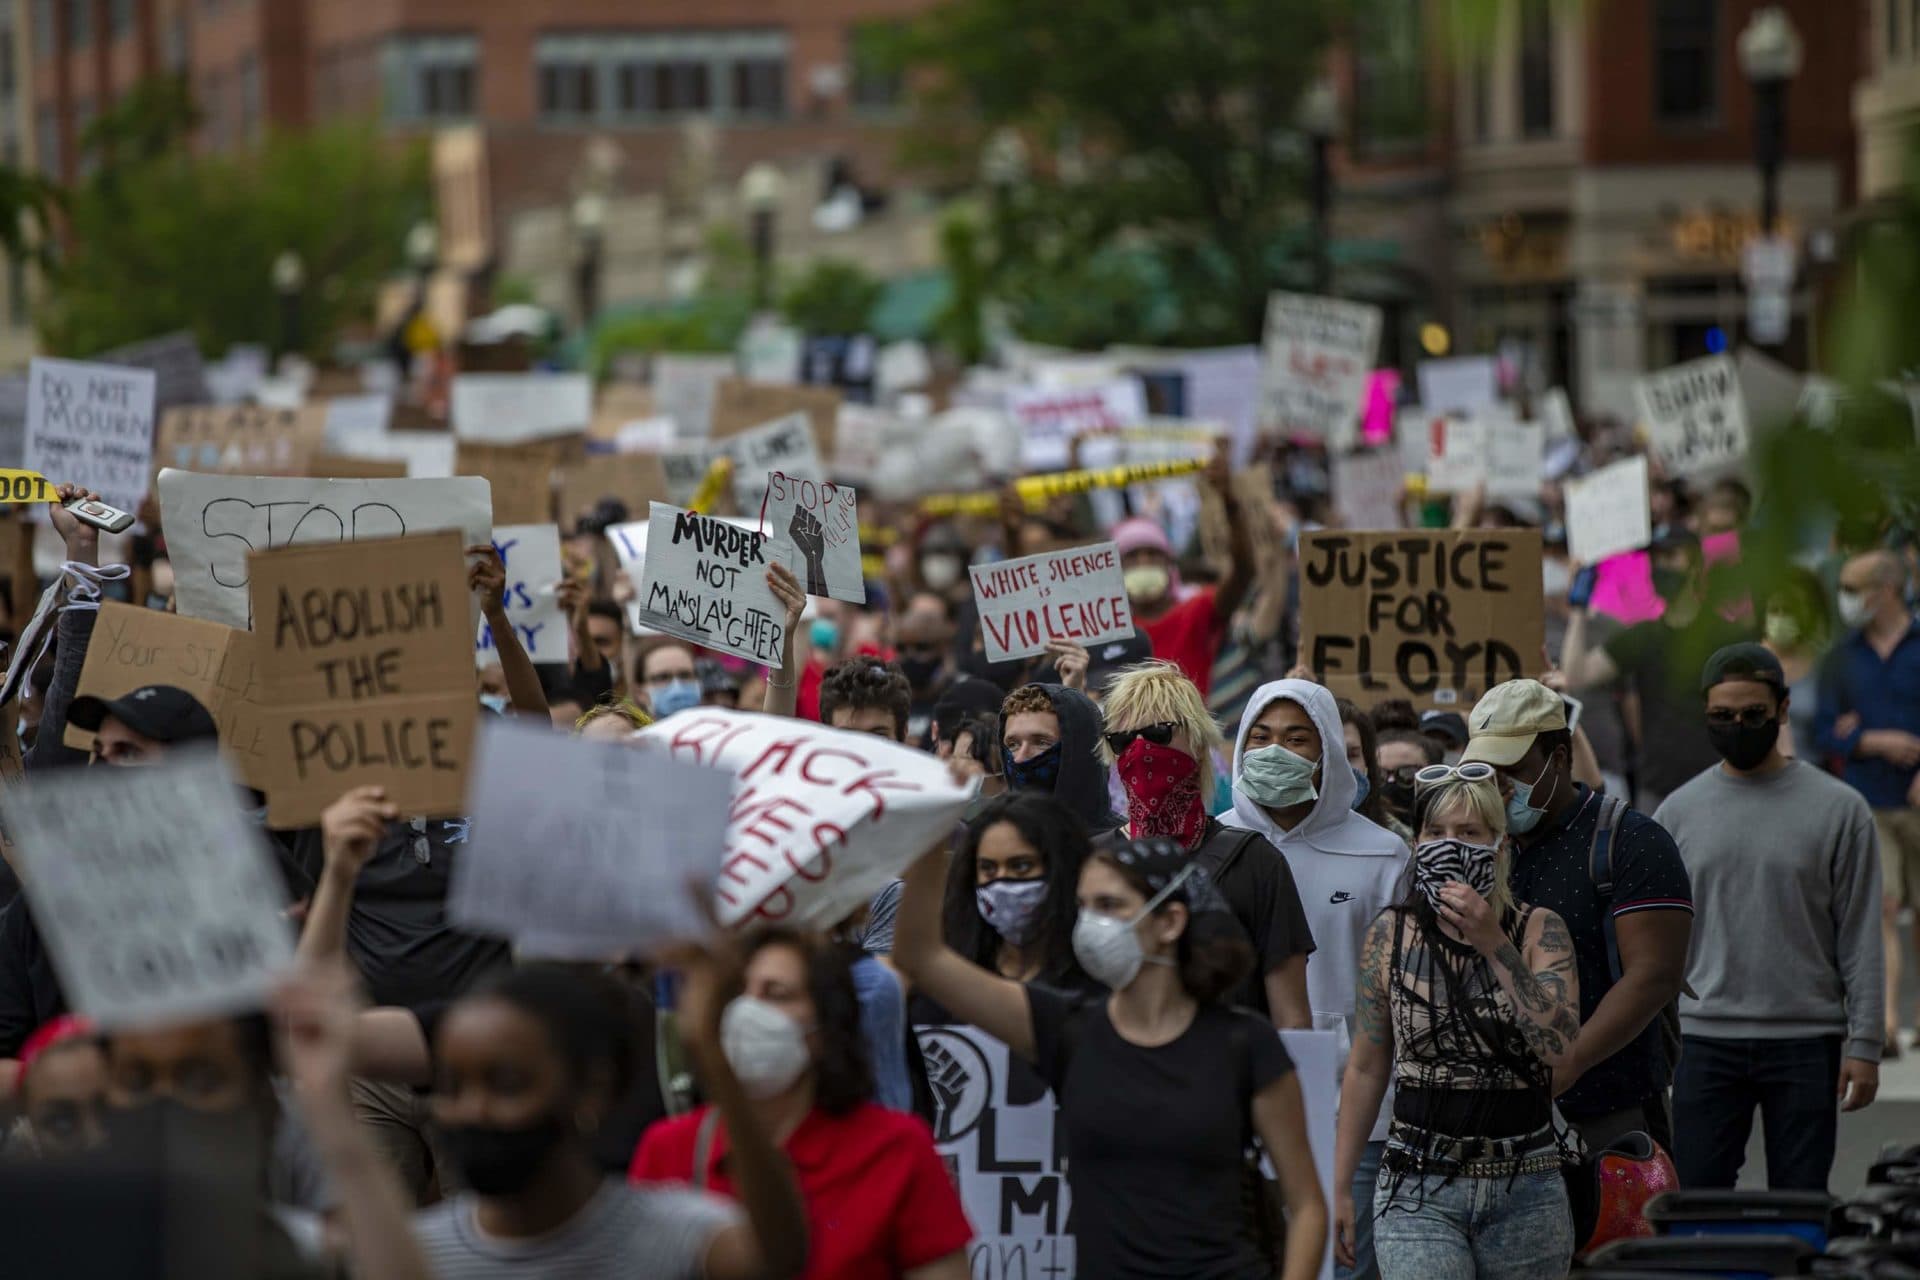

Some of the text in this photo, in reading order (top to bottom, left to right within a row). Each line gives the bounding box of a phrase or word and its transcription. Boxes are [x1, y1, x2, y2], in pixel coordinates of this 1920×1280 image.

[87, 377, 131, 408] NOT
[45, 400, 151, 439] MOURN
[772, 472, 838, 523] STOP
[823, 491, 856, 549] KILLING
[671, 511, 765, 568] MURDER
[1306, 537, 1510, 592] JUSTICE
[696, 559, 742, 592] NOT
[974, 551, 1115, 599] WHITE SILENCE
[1038, 586, 1051, 598] is
[274, 579, 444, 650] ABOLISH
[647, 580, 783, 664] MANSLAUGHTER
[984, 596, 1127, 652] VIOLENCE
[1368, 590, 1455, 637] FOR
[104, 617, 163, 668] Your
[1313, 634, 1522, 695] FLOYD
[315, 648, 403, 700] THE
[290, 718, 458, 780] POLICE
